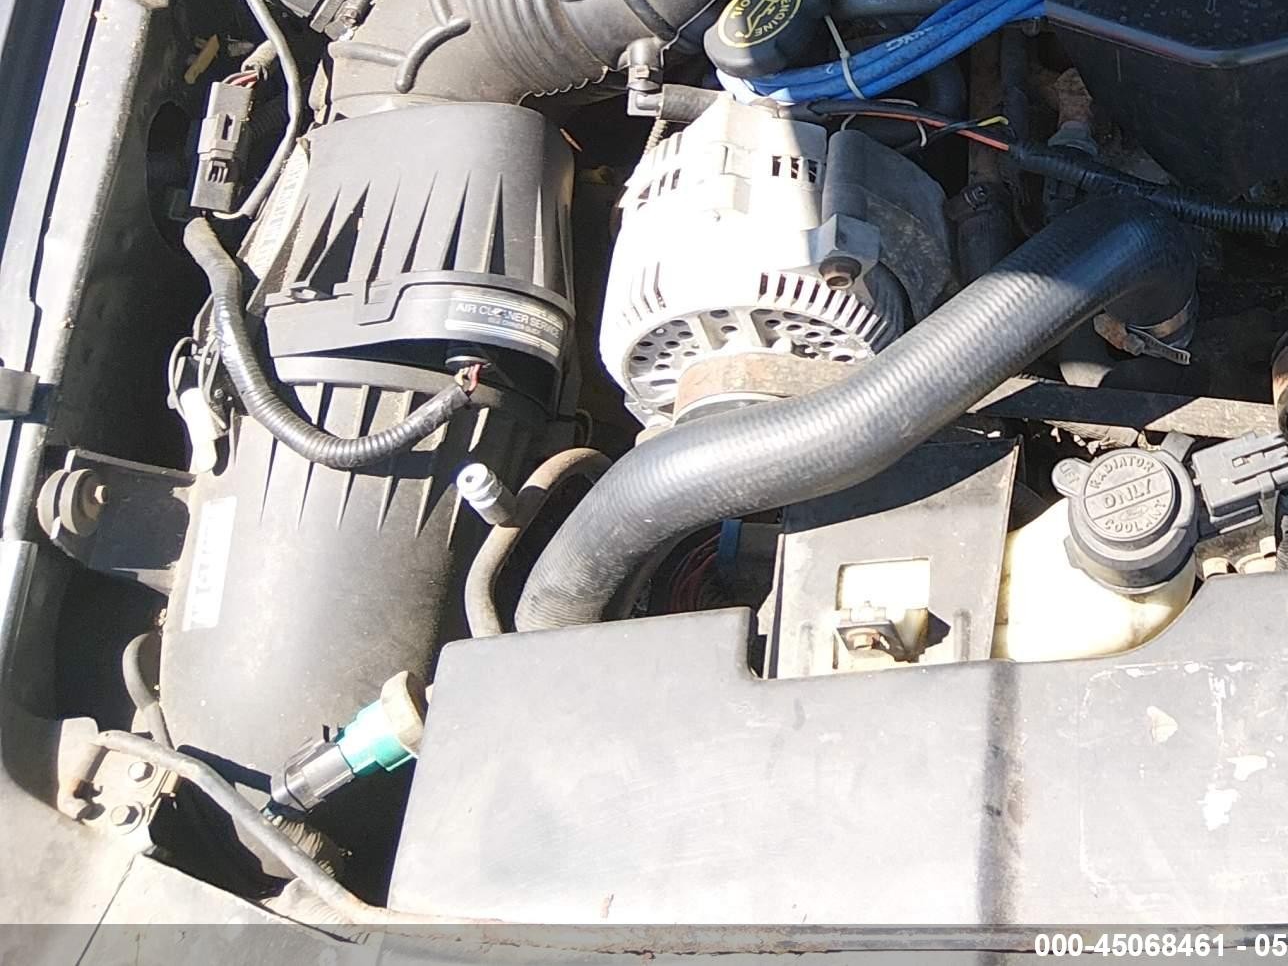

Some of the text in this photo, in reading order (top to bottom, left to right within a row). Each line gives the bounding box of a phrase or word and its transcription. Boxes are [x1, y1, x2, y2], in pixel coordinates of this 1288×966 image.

[456, 303, 477, 314] AIR
[530, 315, 560, 339] SERVICE
[1089, 455, 1155, 490] RADIATOR
[1103, 478, 1152, 510] ONLY
[1104, 499, 1167, 533] COOLANT
